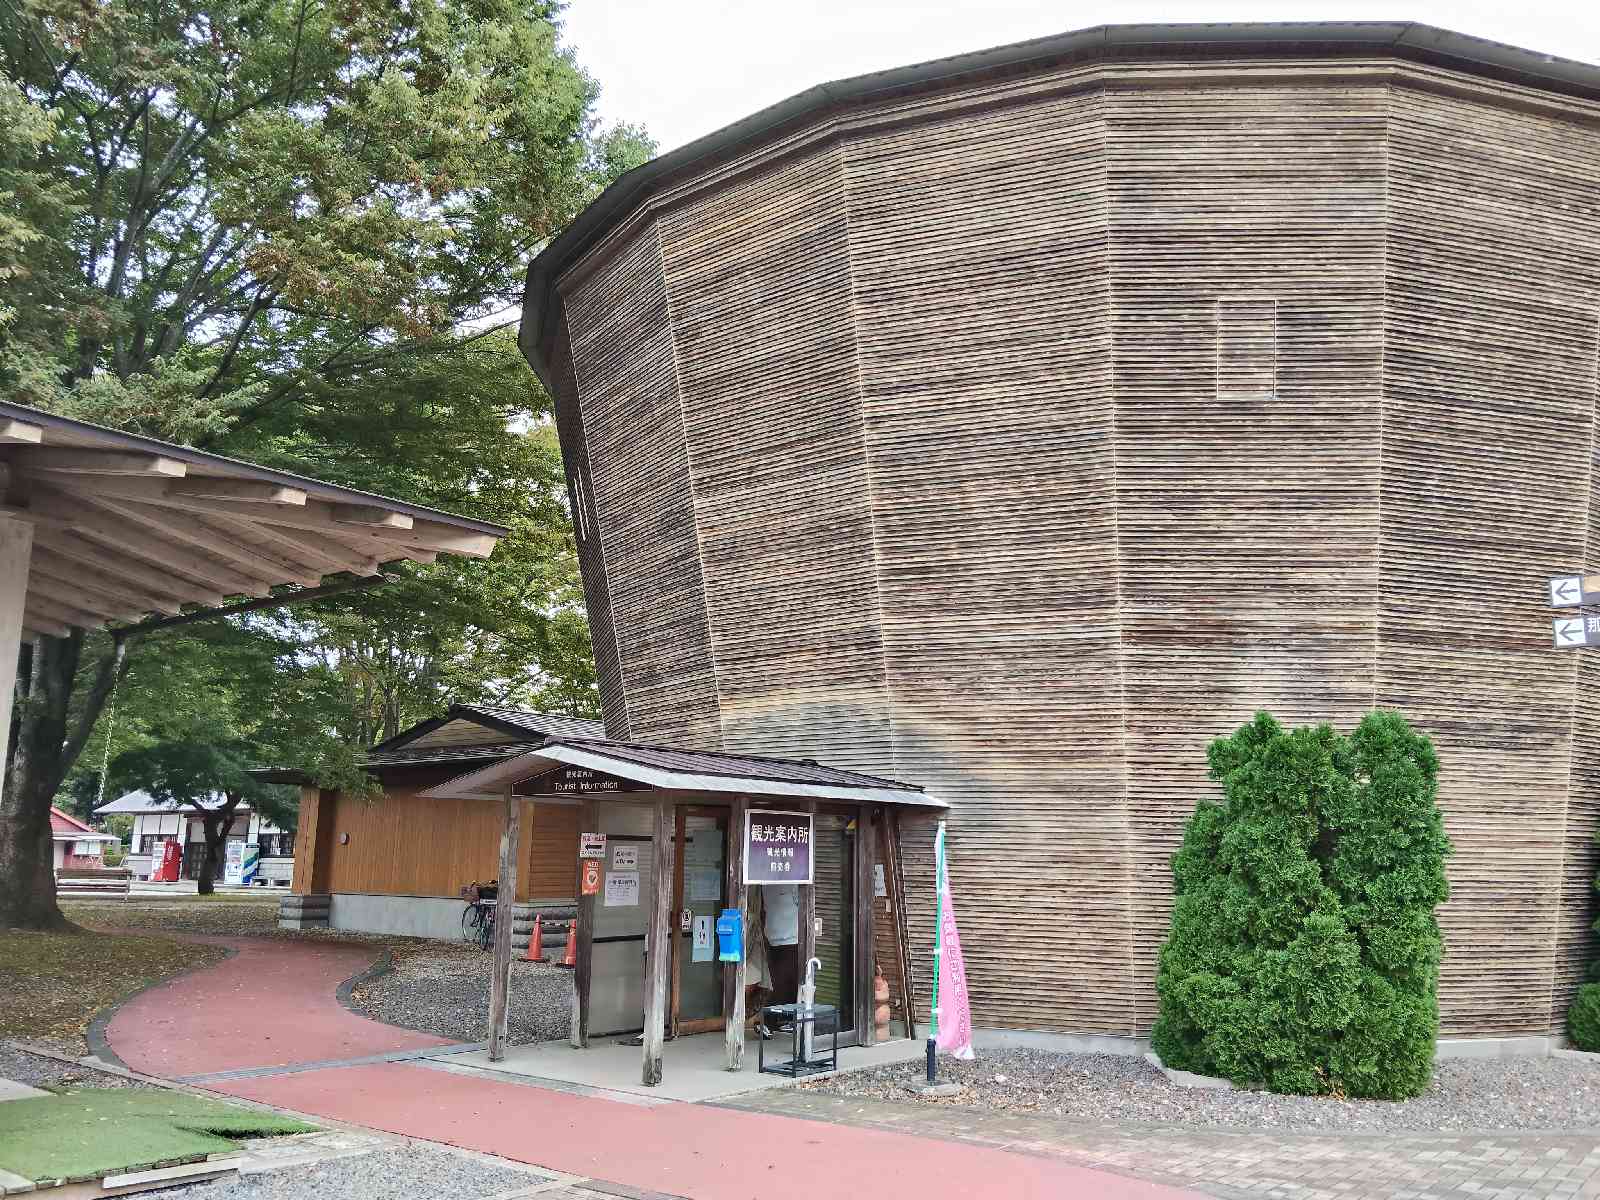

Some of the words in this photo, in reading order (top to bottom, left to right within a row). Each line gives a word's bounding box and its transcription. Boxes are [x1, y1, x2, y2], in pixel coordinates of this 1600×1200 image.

[554, 782, 577, 791] Tourist
[751, 823, 809, 844] 観光案内所
